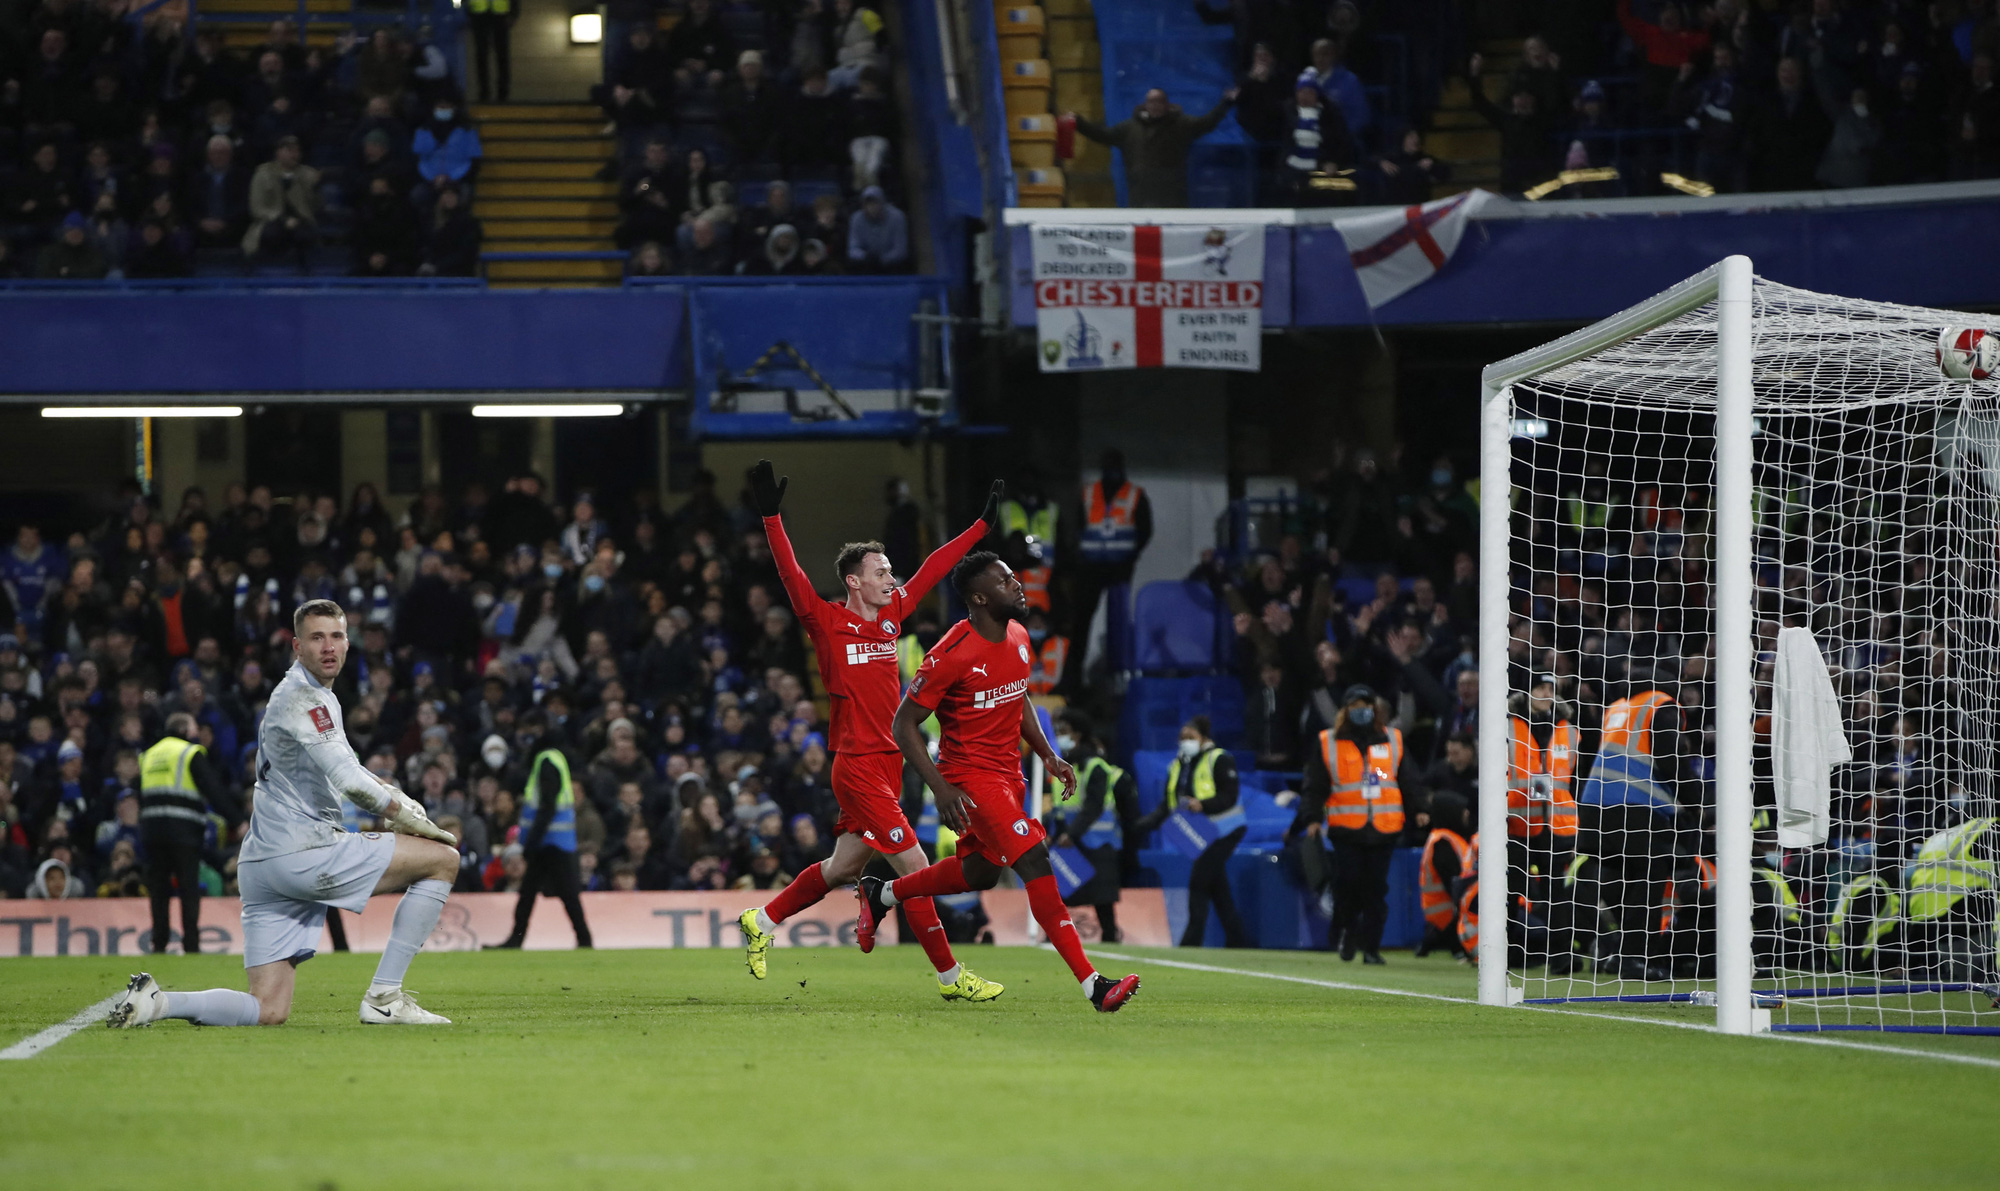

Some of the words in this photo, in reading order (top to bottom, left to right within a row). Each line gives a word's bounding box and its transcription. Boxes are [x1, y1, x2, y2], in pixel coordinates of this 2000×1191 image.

[1058, 244, 1079, 257] TO
[1042, 262, 1127, 275] DEDICATED
[1038, 281, 1261, 306] CHESTERFIELD
[1179, 313, 1217, 326] EVER
[1220, 313, 1248, 326] THE
[1192, 331, 1237, 344] FAITH
[1180, 349, 1249, 364] ENDURES
[856, 639, 898, 653] TECHNIQ
[653, 910, 882, 947] Thee
